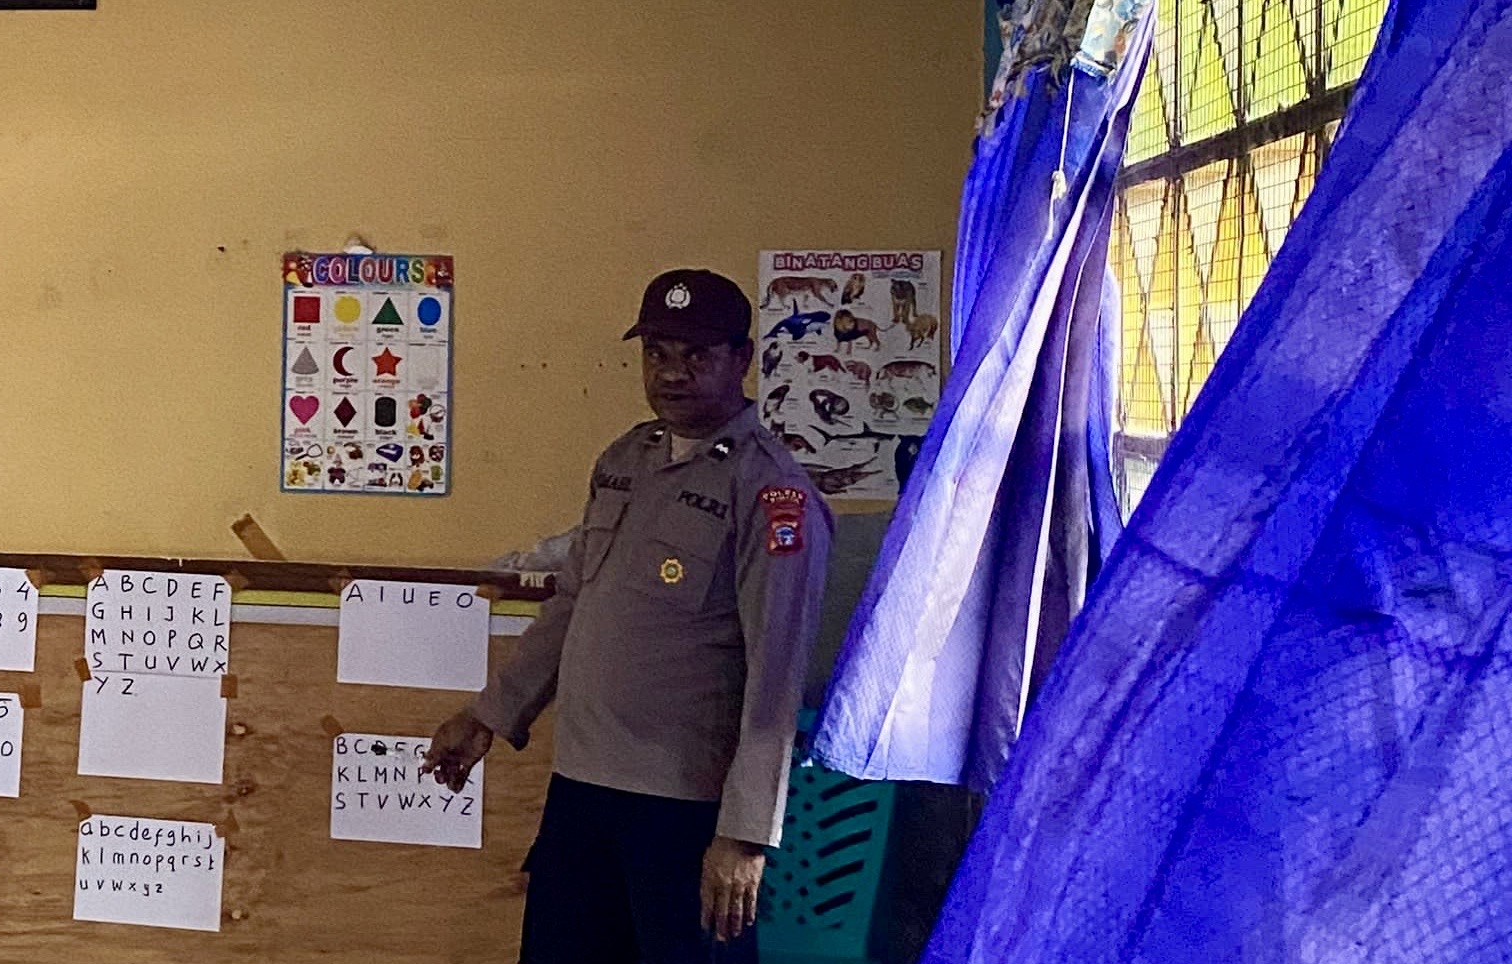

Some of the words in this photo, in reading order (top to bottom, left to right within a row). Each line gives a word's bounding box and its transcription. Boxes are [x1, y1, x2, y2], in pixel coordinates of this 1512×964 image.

[313, 256, 425, 285] COLOURS
[774, 253, 869, 271] BINATANG
[871, 253, 923, 270] BUAS
[678, 490, 728, 519] POLRI
